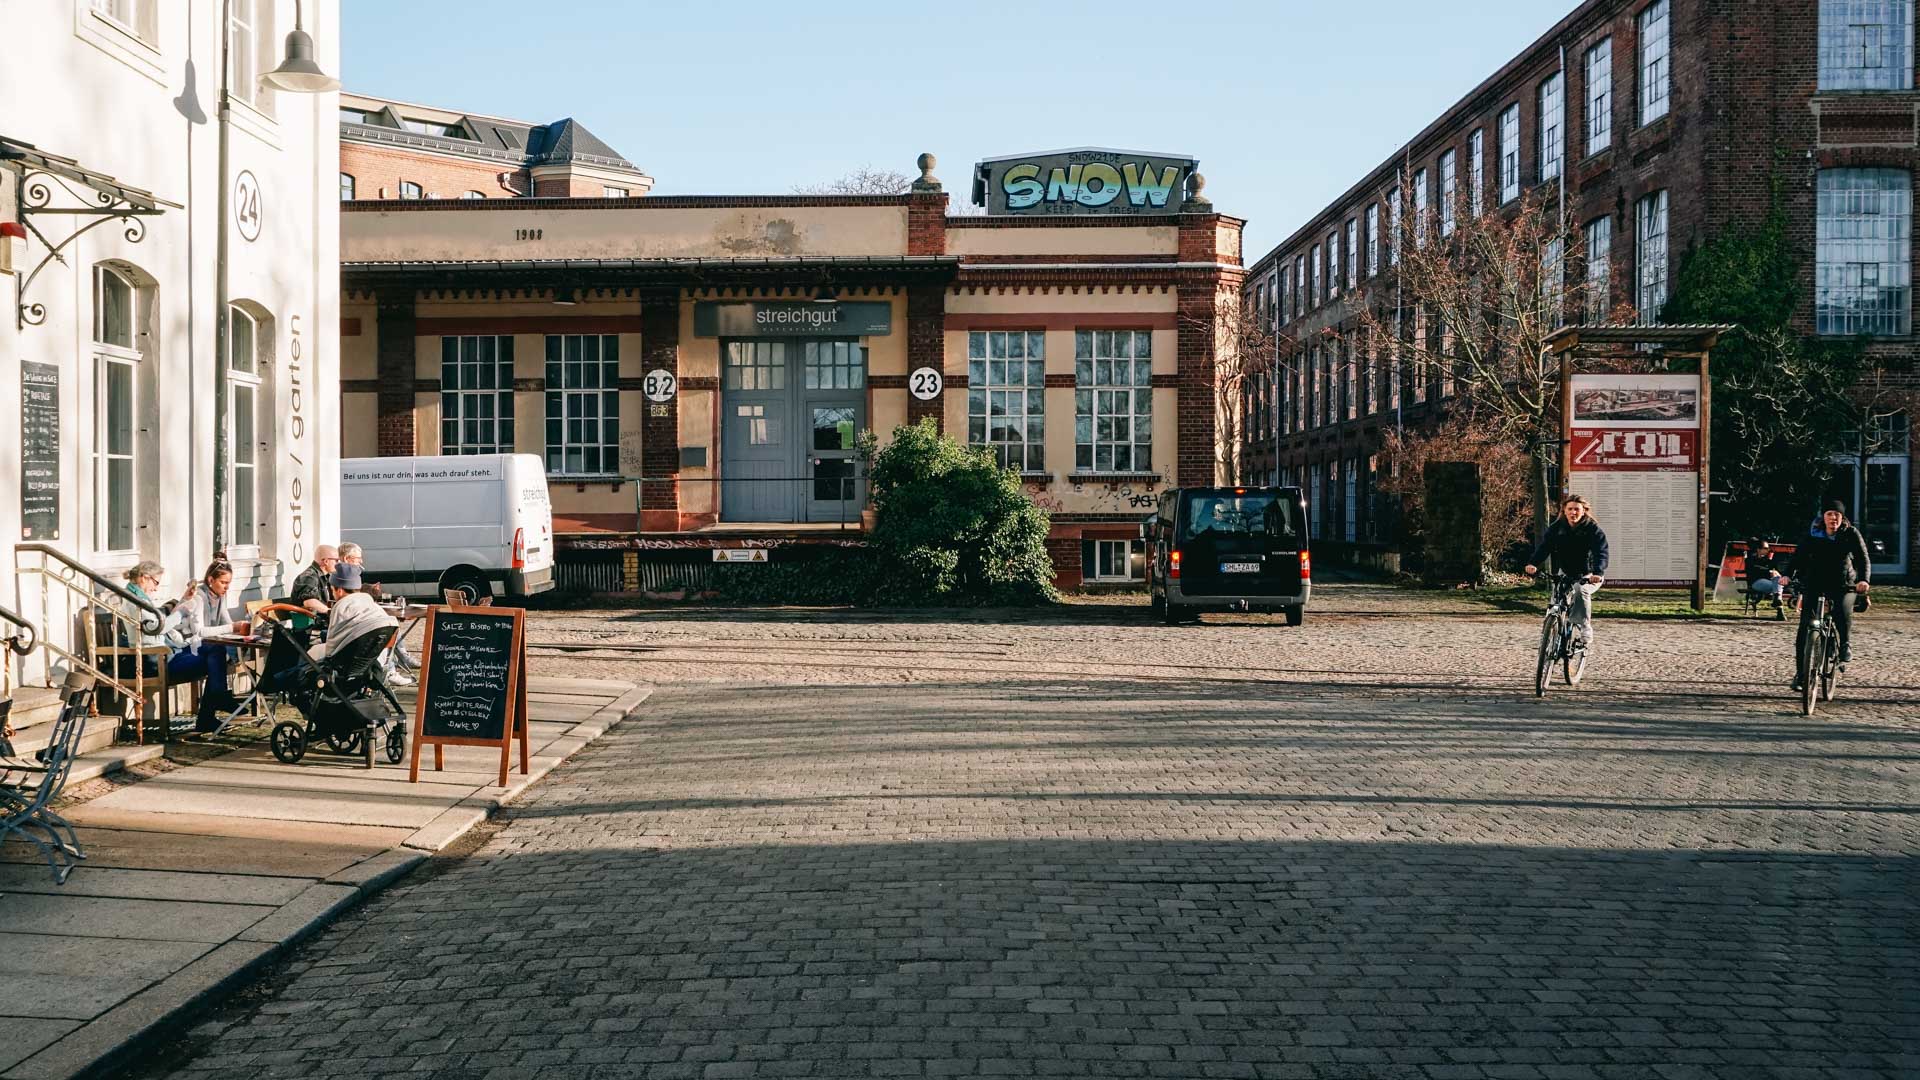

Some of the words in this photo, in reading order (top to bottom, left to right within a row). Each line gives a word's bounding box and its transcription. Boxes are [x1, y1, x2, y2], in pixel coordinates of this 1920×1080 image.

[1003, 161, 1179, 209] SNOW
[238, 183, 258, 227] 24
[1045, 205, 1073, 214] KEEP
[1109, 206, 1140, 215] FRESH
[516, 229, 543, 241] 1908
[756, 307, 837, 327] streichgut
[288, 313, 304, 440] garten
[914, 373, 938, 393] 23
[371, 471, 381, 479] ist
[430, 470, 448, 478] auch
[449, 469, 470, 477] drauf
[470, 469, 493, 477] steht.
[289, 477, 303, 565] cafe
[441, 621, 464, 631] SALZ
[447, 720, 473, 731] DANKE
